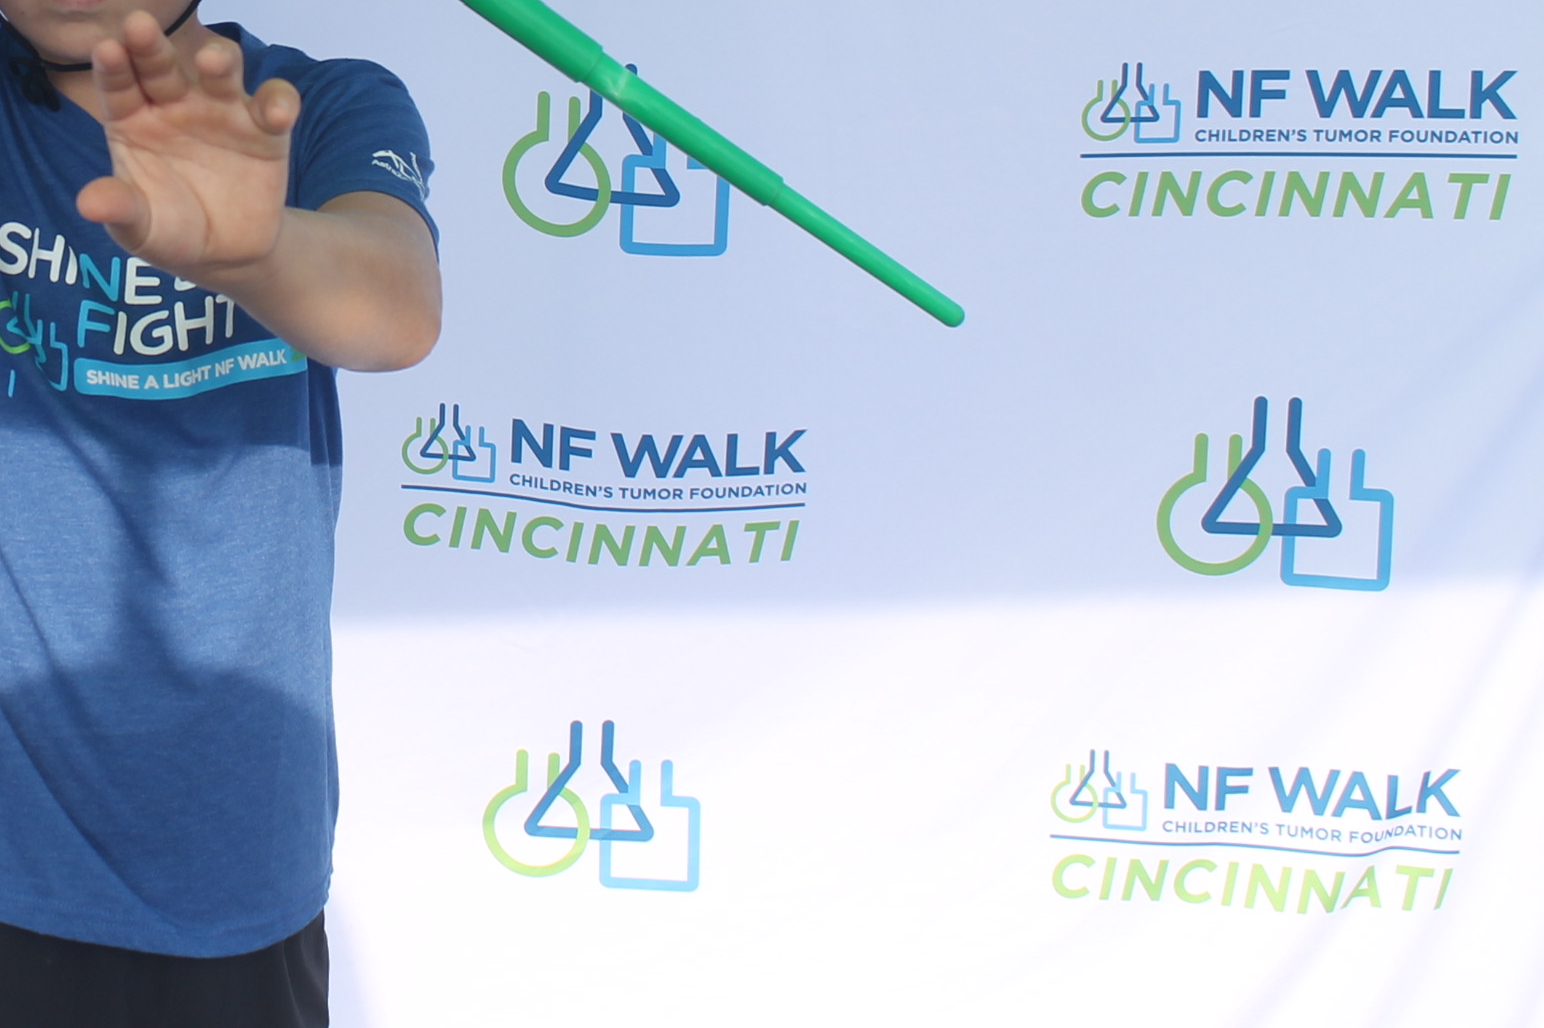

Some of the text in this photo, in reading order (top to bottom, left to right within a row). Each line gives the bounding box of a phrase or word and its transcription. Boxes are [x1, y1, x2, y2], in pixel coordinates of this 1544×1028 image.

[1196, 69, 1519, 120] NF WALK
[1194, 129, 1519, 145] CHILDREN'S TUMOR FOUNDATION
[1081, 170, 1512, 221] CINCINNATI
[77, 295, 238, 356] FIGHT
[86, 348, 288, 390] SHINE A LIGHT NF WALK
[511, 418, 807, 479] NF WALK
[509, 473, 807, 500] CHILDREN'S TUMOR FOUNDATION
[403, 503, 800, 567] CINCINNATI
[1164, 763, 1461, 820] NF WALK
[1275, 823, 1341, 842] TUMOR
[1349, 825, 1462, 843] FOUNDATION
[1052, 853, 1454, 915] CINCINNATI
